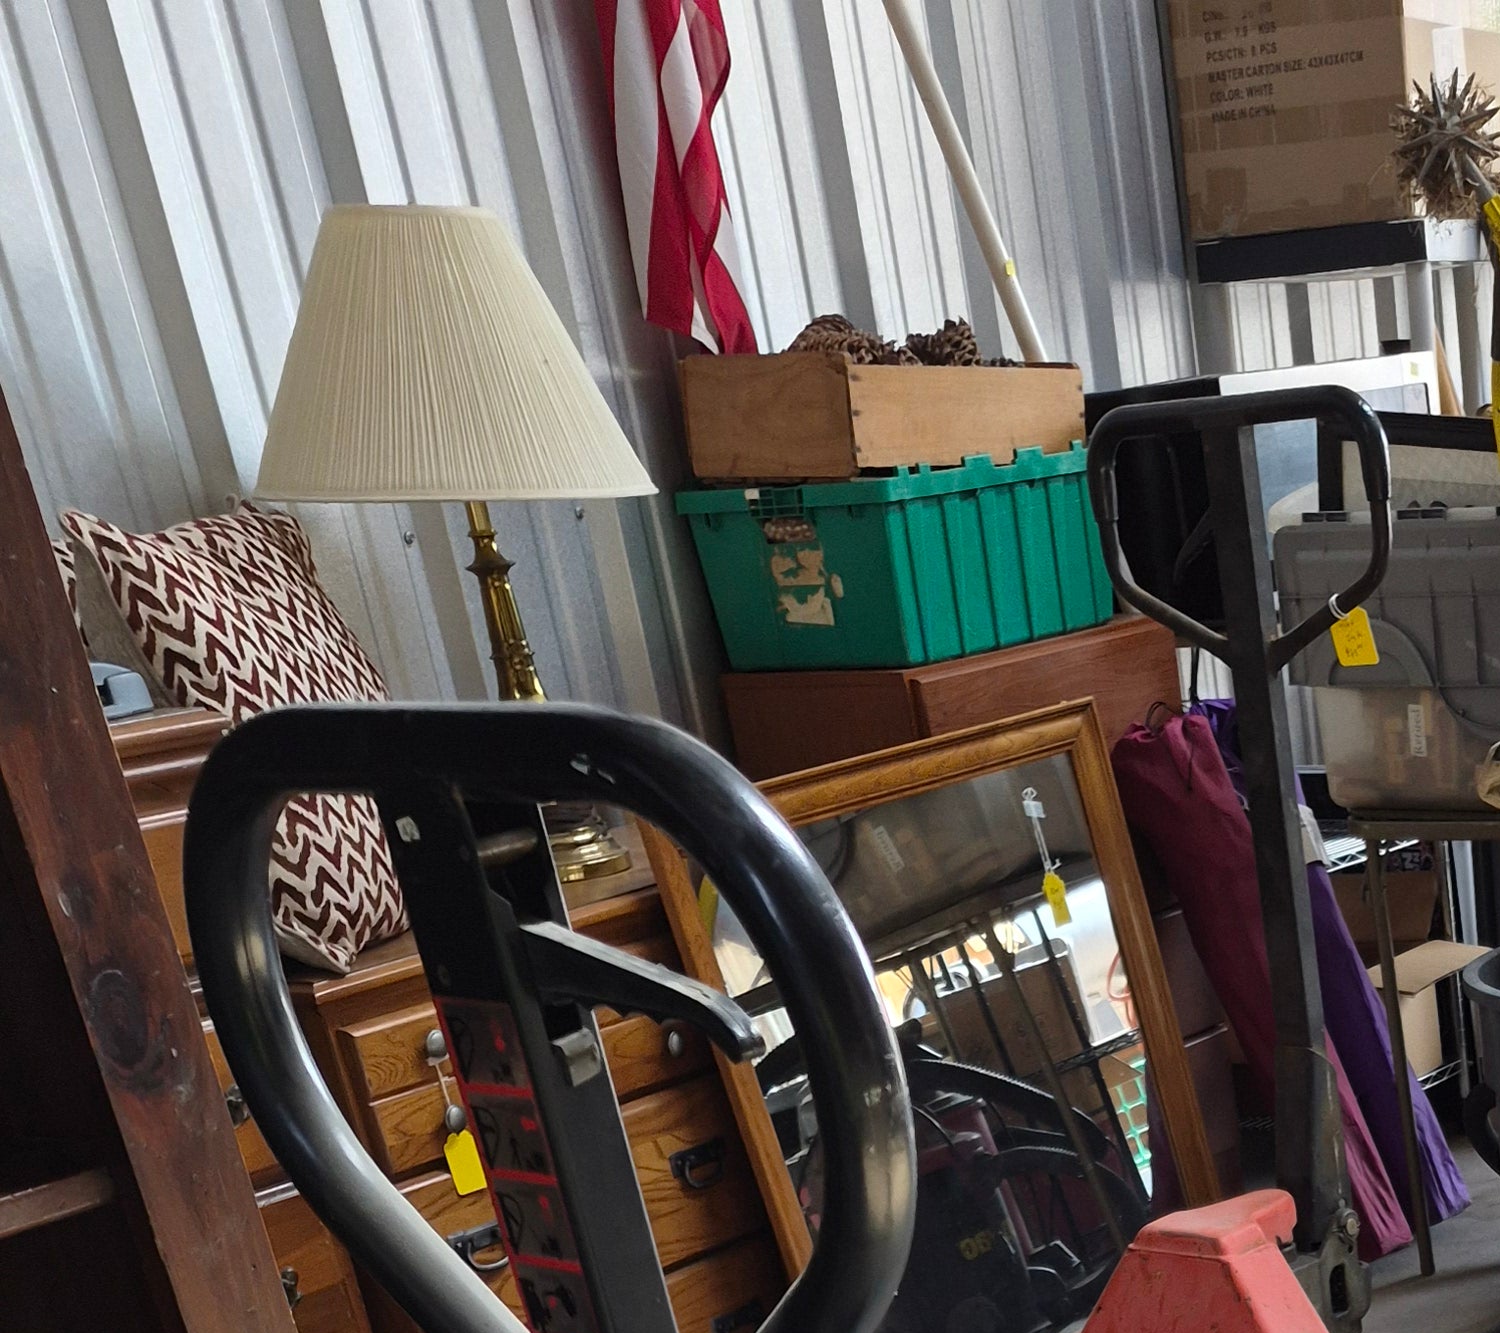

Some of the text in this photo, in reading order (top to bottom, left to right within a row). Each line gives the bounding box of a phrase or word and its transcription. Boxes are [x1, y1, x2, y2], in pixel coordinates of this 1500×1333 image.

[1208, 67, 1244, 83] MASTER
[1246, 62, 1282, 78] CARTON
[1246, 83, 1274, 98] WHITE
